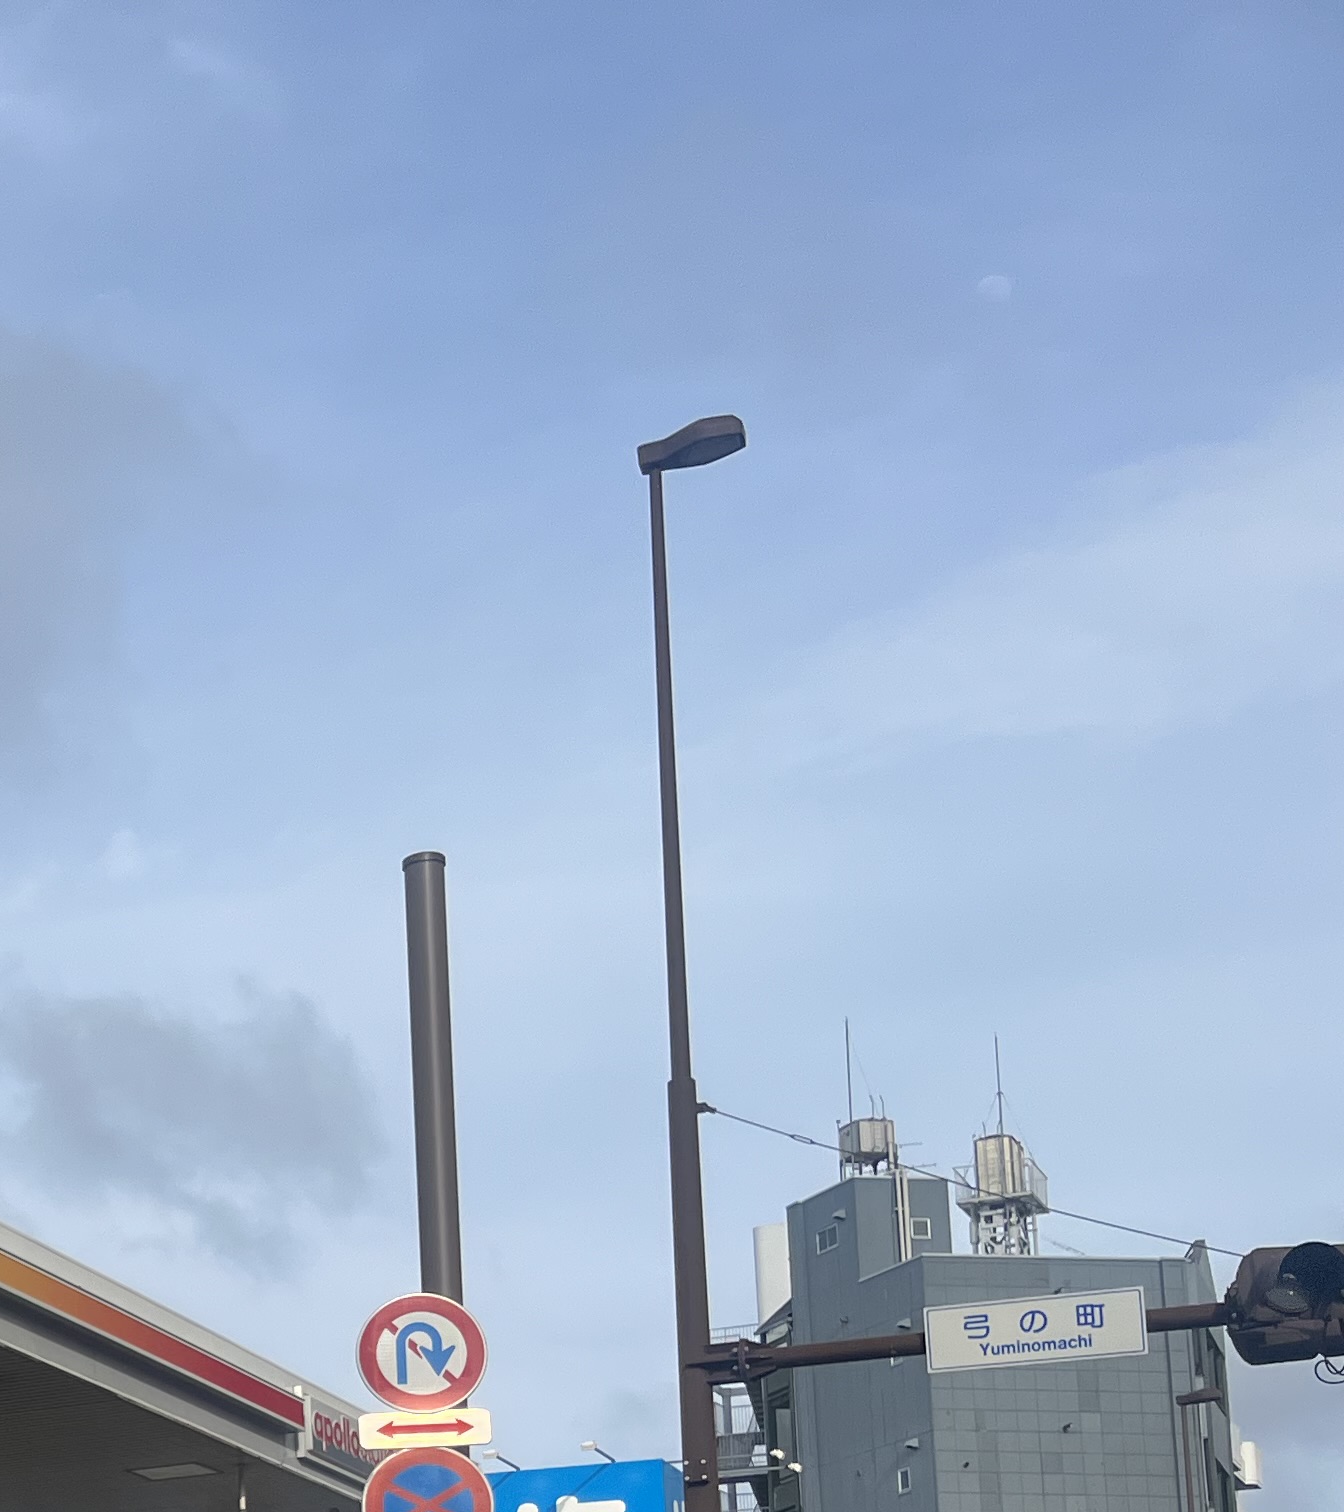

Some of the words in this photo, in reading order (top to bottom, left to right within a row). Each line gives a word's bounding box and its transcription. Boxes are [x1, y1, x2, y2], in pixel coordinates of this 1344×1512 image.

[963, 1303, 1105, 1340] 弓の町
[979, 1334, 1093, 1357] Yuminomachi
